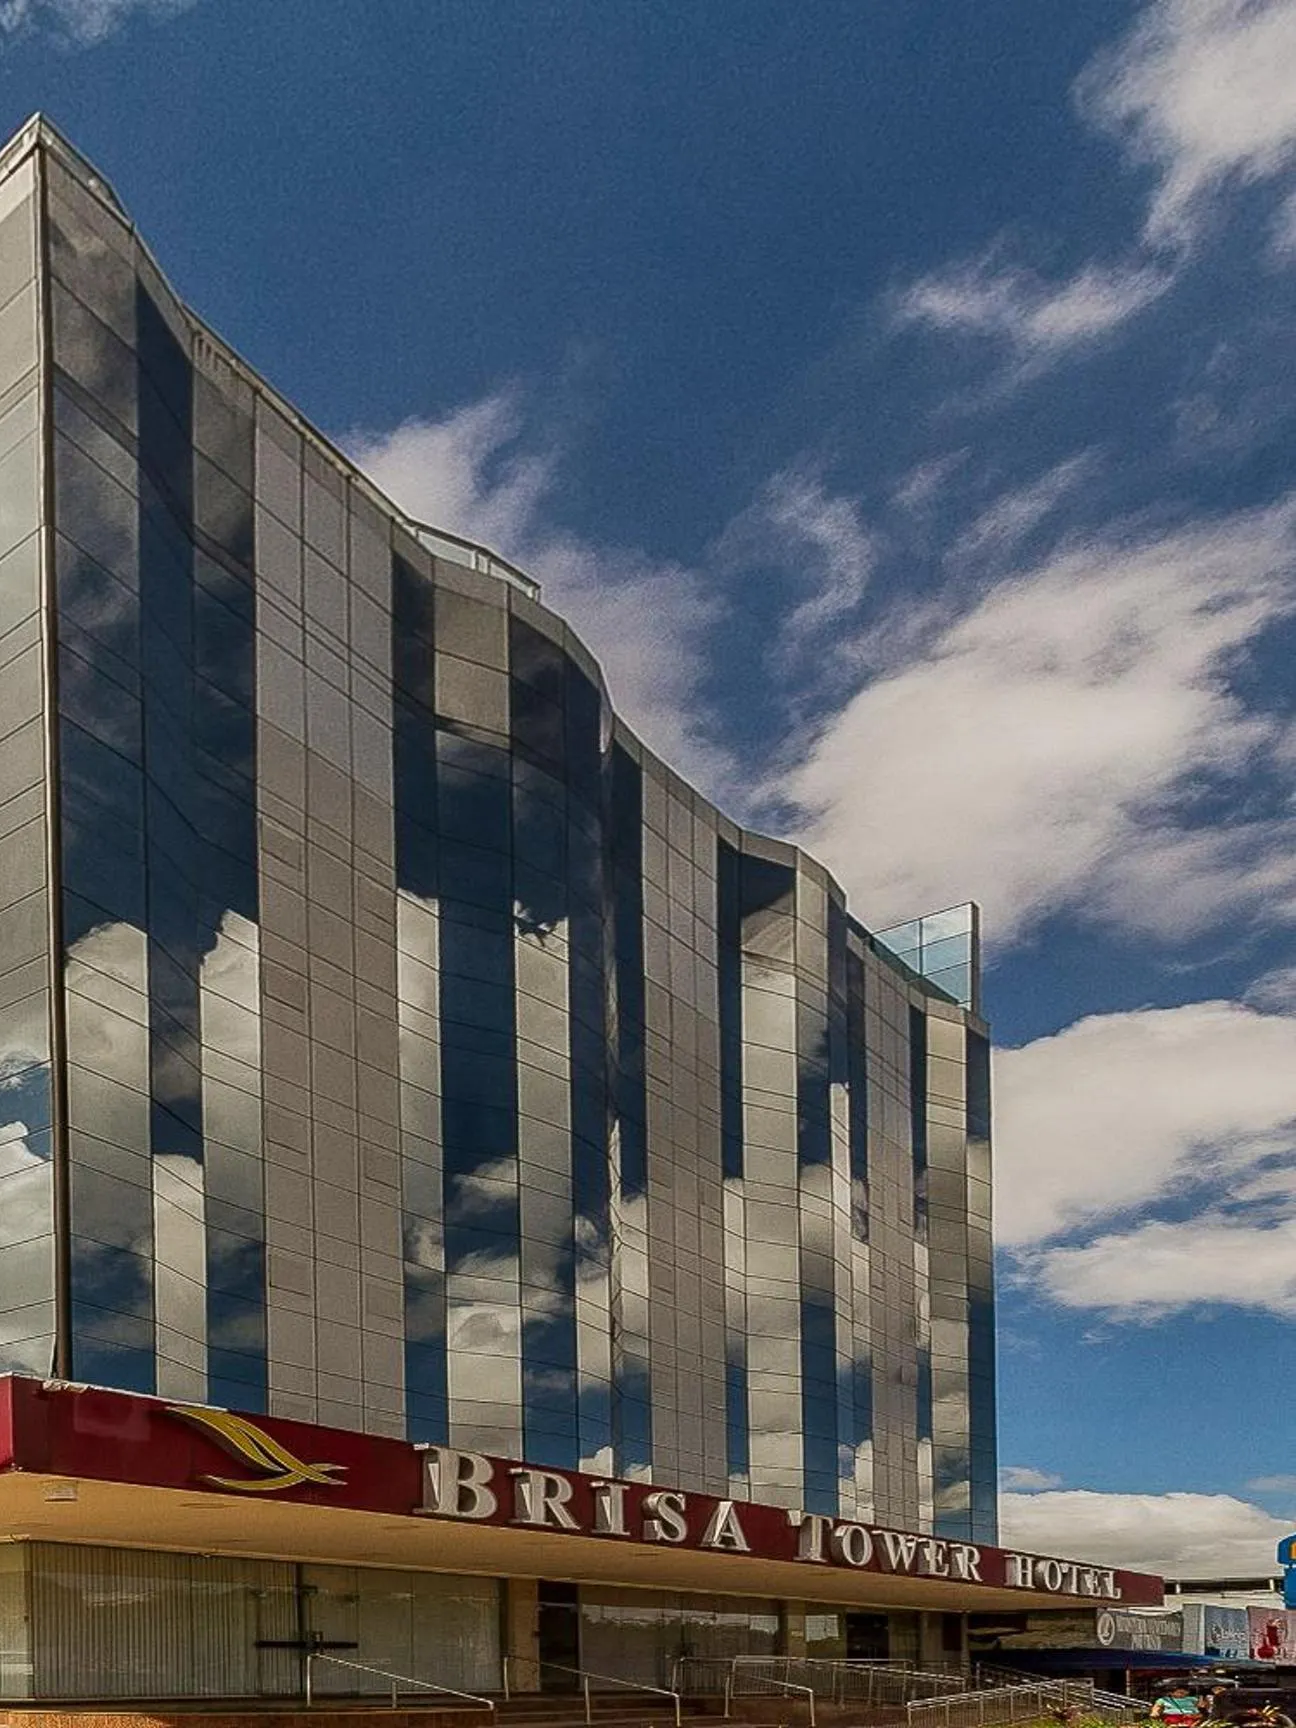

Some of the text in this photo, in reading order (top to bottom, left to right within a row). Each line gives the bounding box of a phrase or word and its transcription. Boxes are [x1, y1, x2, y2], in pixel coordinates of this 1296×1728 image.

[413, 1443, 1122, 1600] BRISA TOWER HOTEL
